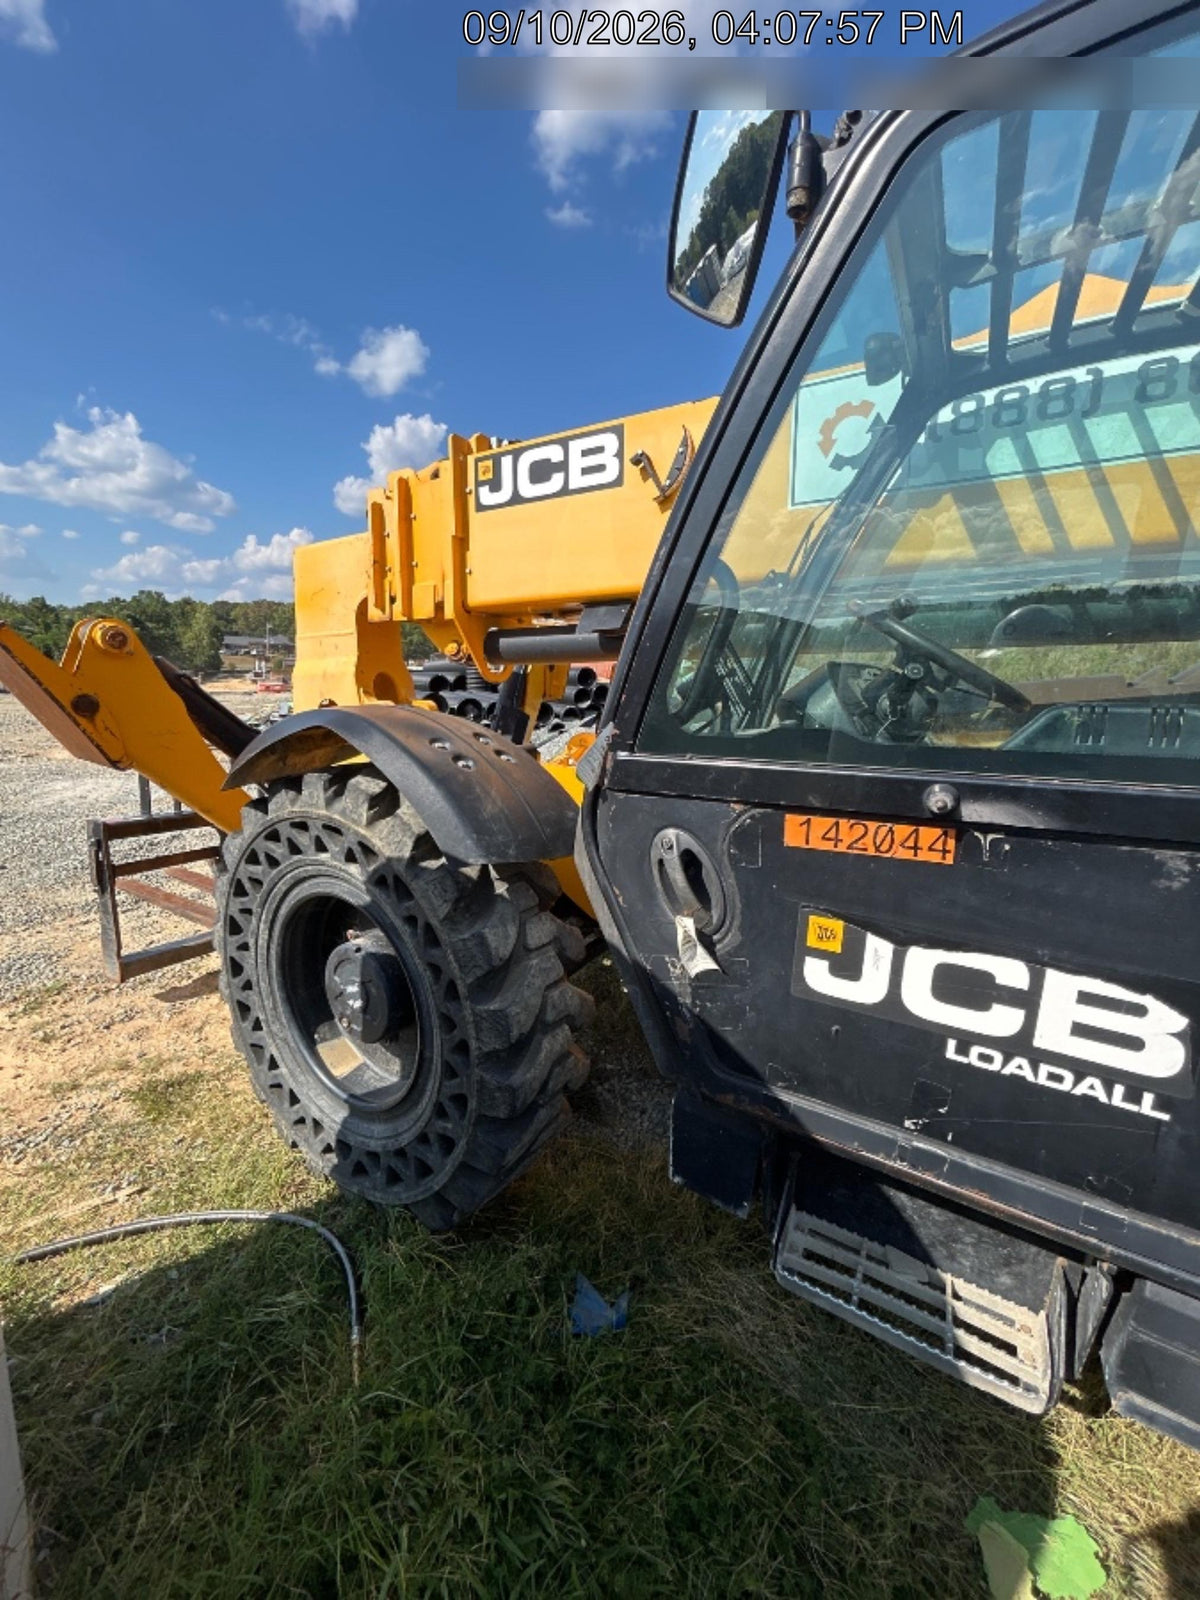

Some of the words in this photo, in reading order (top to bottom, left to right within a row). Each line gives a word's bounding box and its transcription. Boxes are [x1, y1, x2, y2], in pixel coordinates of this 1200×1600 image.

[478, 432, 620, 506] JCB
[799, 817, 952, 861] 142044
[803, 931, 1190, 1079] JCB
[945, 1037, 1172, 1121] LOADALL
